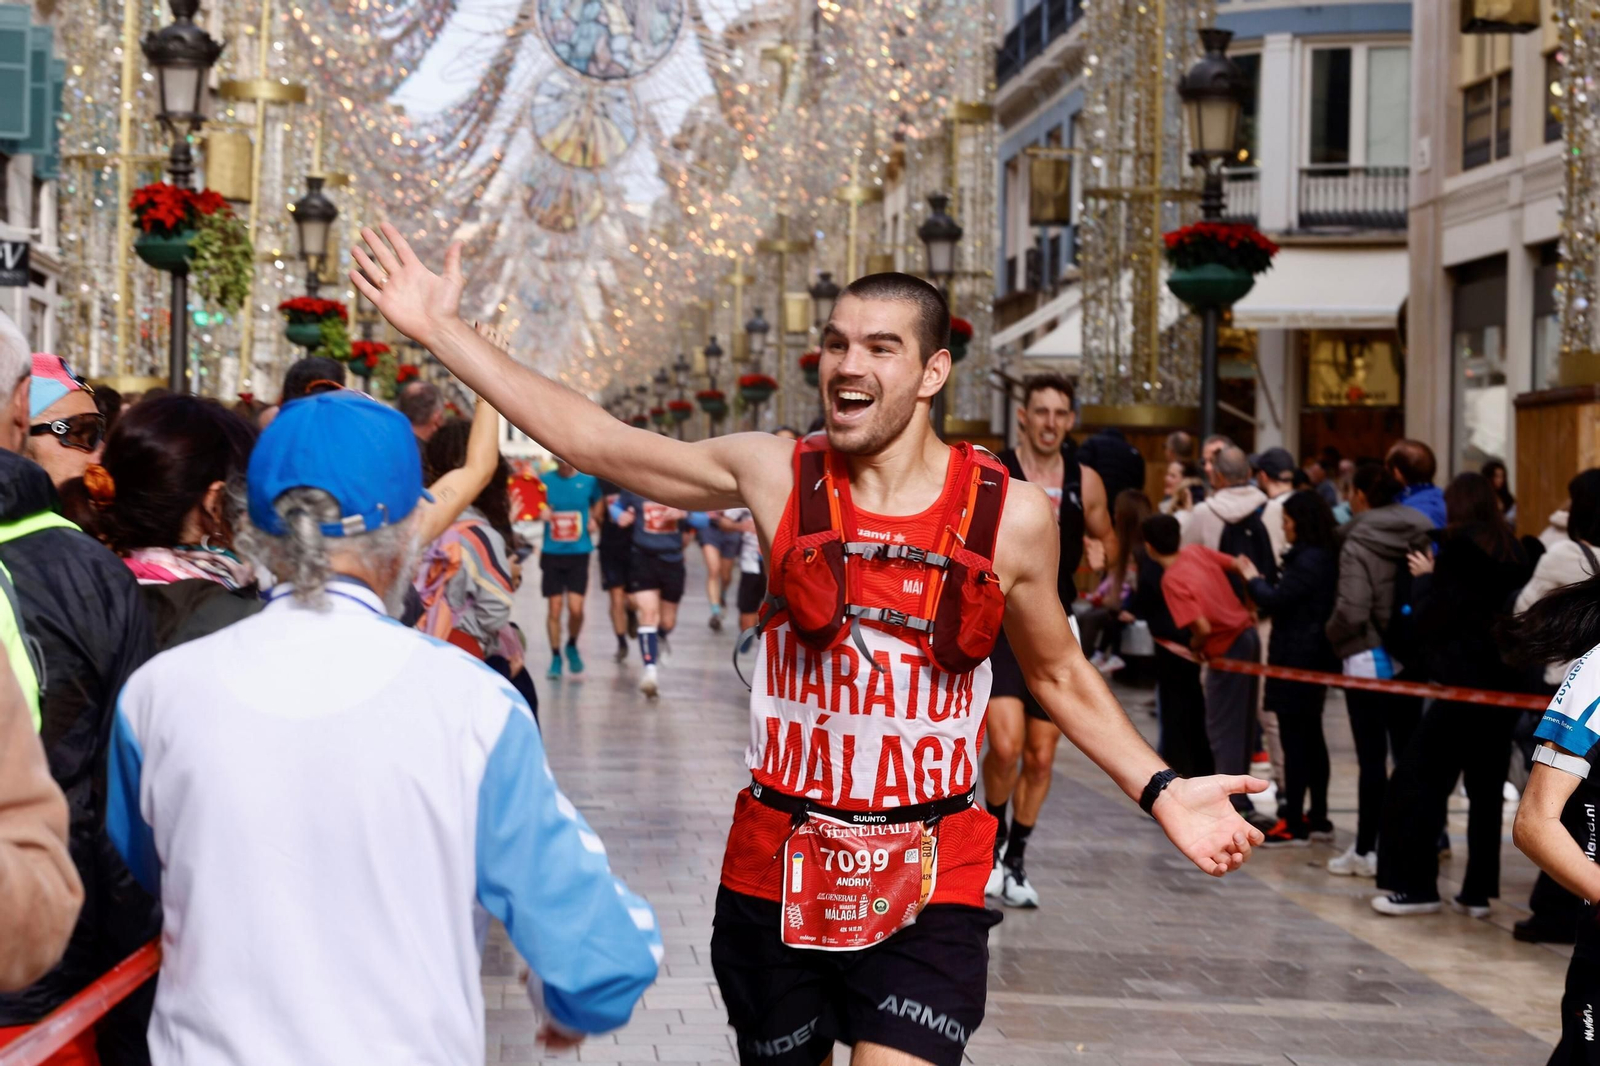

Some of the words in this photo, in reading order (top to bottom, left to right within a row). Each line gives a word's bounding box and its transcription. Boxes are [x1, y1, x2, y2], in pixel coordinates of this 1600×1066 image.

[762, 714, 973, 807] MÁLAGA
[853, 815, 887, 823] SUUNTO
[819, 821, 912, 839] GENERALI
[820, 847, 889, 873] 7099
[836, 877, 871, 887] ANDRIY
[825, 893, 857, 902] GENERALI
[825, 904, 857, 920] MÁLAGA
